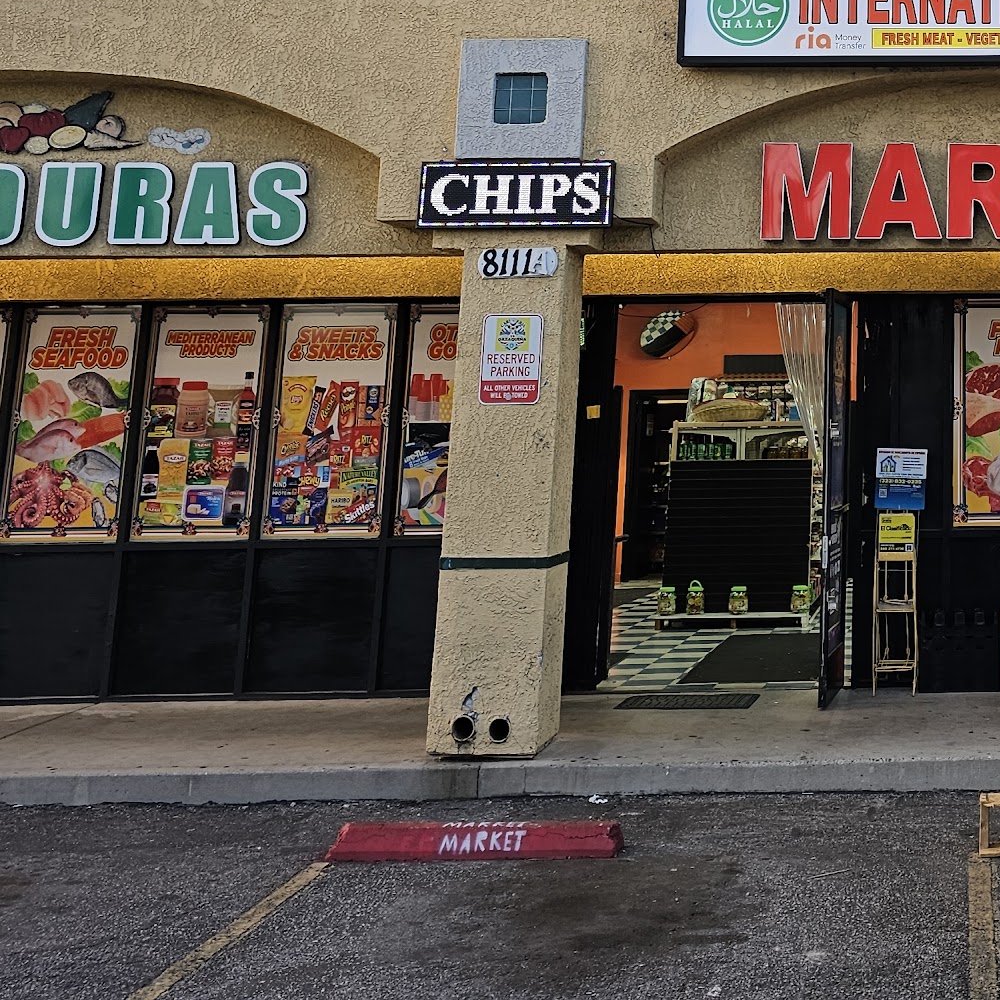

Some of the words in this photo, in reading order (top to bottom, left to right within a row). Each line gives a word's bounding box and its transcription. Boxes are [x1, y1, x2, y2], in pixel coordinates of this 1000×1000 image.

[720, 18, 775, 29] HALAL
[795, 26, 832, 50] ria
[835, 33, 863, 44] Money
[881, 32, 919, 46] FRESH
[922, 32, 955, 46] MEAT
[835, 42, 867, 50] Transfer
[430, 172, 601, 216] CHIPS
[47, 326, 118, 348] FRESH
[166, 330, 255, 345] MEDITERRANEAN
[297, 326, 378, 344] SWEETS
[180, 343, 238, 358] PRODUCTS
[289, 343, 304, 361] &
[306, 343, 385, 361] SNACKS
[29, 348, 129, 369] SEAFOOD
[487, 353, 536, 365] RESERVED
[490, 366, 531, 377] PARKING
[512, 384, 536, 392] VEHICLES
[344, 500, 376, 523] Skittles
[438, 830, 528, 855] MARKET
